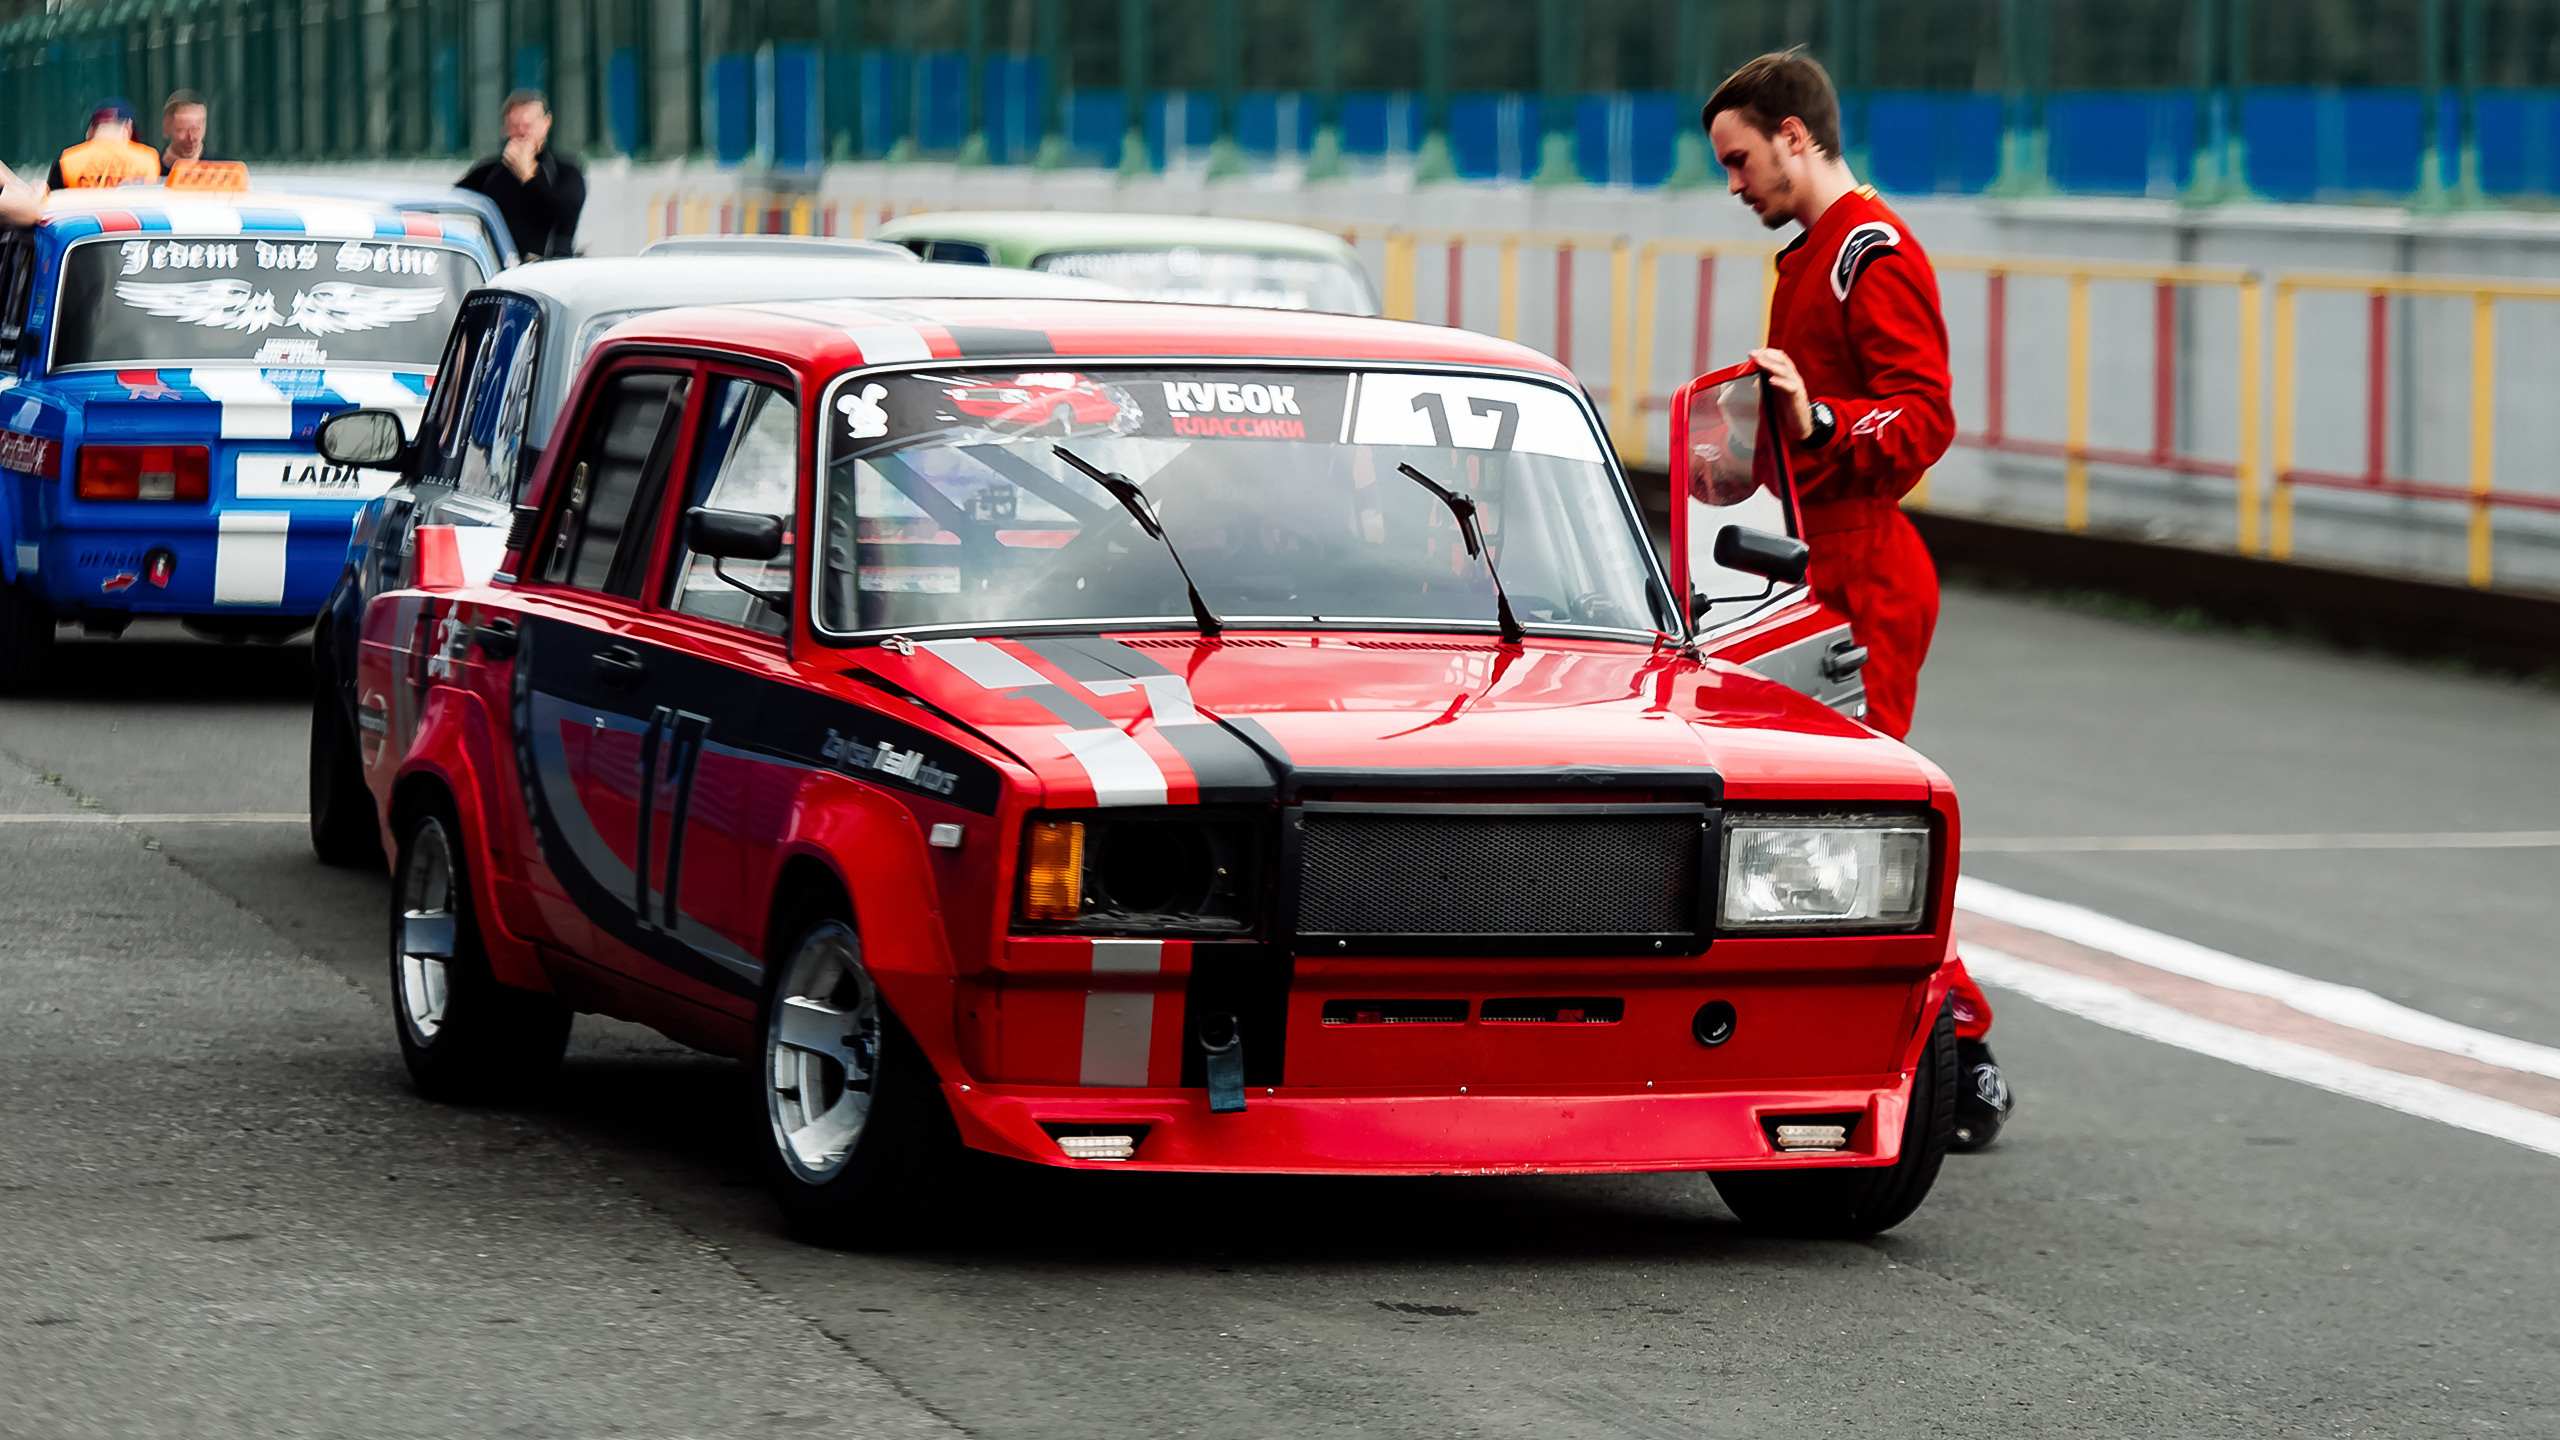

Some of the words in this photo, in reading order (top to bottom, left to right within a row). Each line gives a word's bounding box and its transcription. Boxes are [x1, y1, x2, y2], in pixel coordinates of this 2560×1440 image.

[120, 240, 239, 275] Jedem
[255, 240, 318, 270] das
[335, 241, 439, 275] Seine
[1162, 381, 1301, 415] КУБОК
[1172, 416, 1306, 438] КЛАССИКИ
[1411, 391, 1519, 451] 17
[281, 460, 360, 488] LADA
